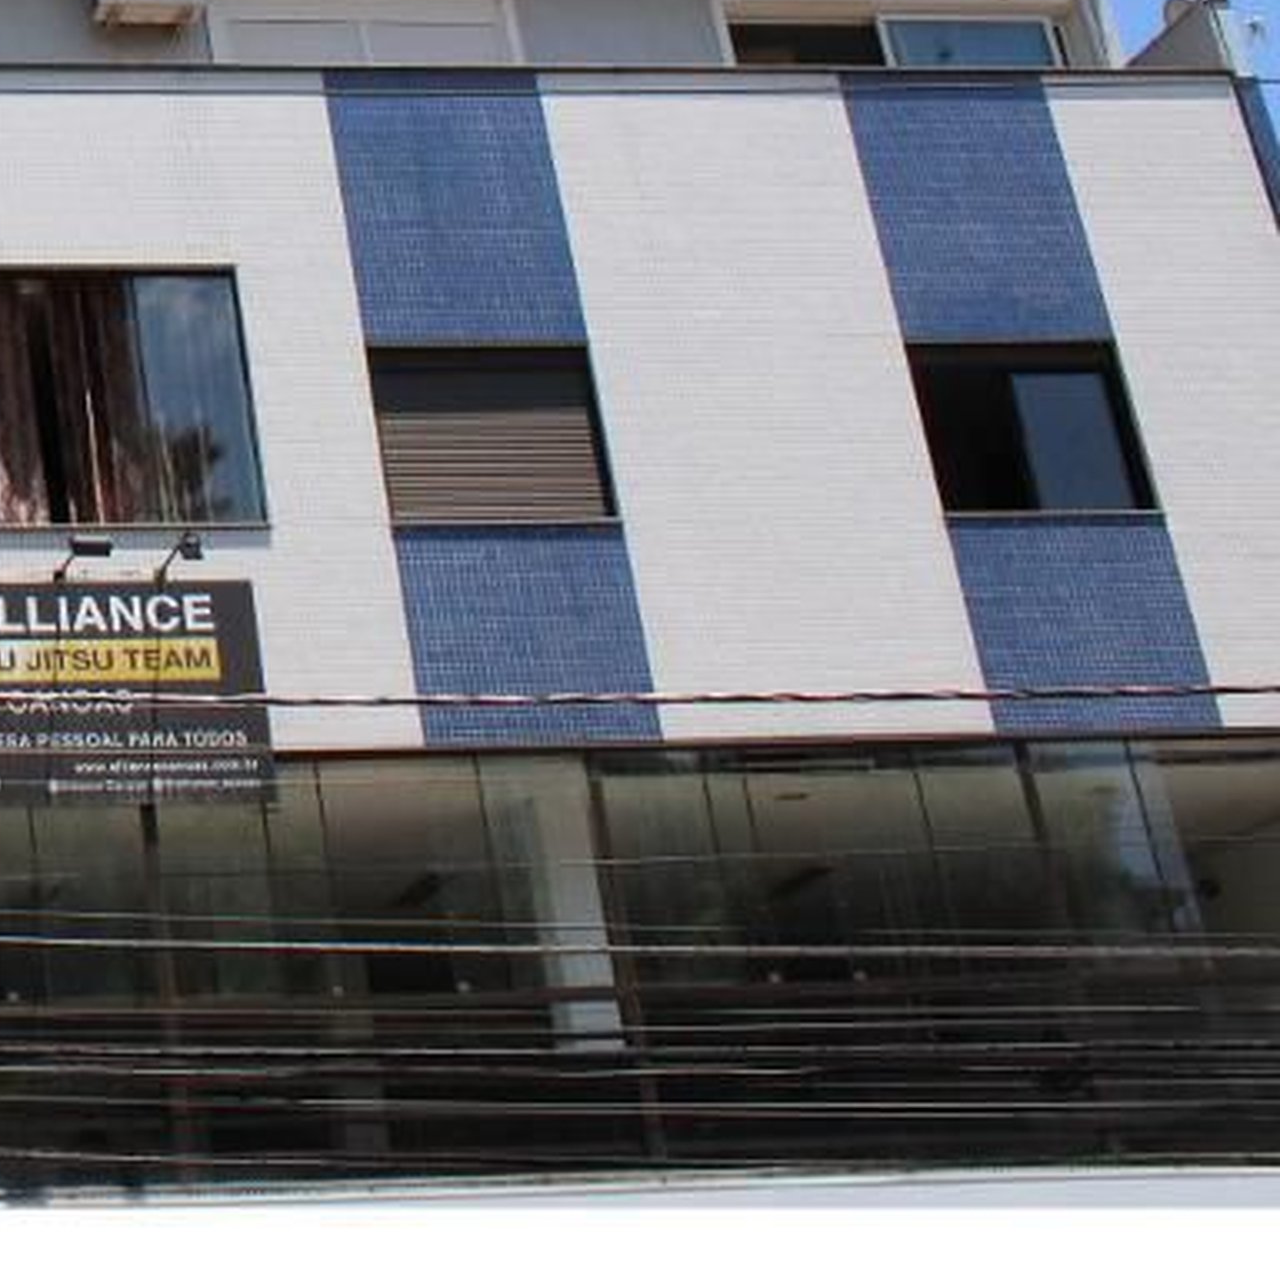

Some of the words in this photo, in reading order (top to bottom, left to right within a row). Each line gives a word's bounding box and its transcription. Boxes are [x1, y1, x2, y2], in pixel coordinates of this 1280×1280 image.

[27, 649, 115, 672] JITSU
[124, 647, 213, 670] TEAM
[36, 731, 124, 748] PESSOAL
[128, 731, 179, 748] PARA
[183, 729, 248, 748] TODOS
